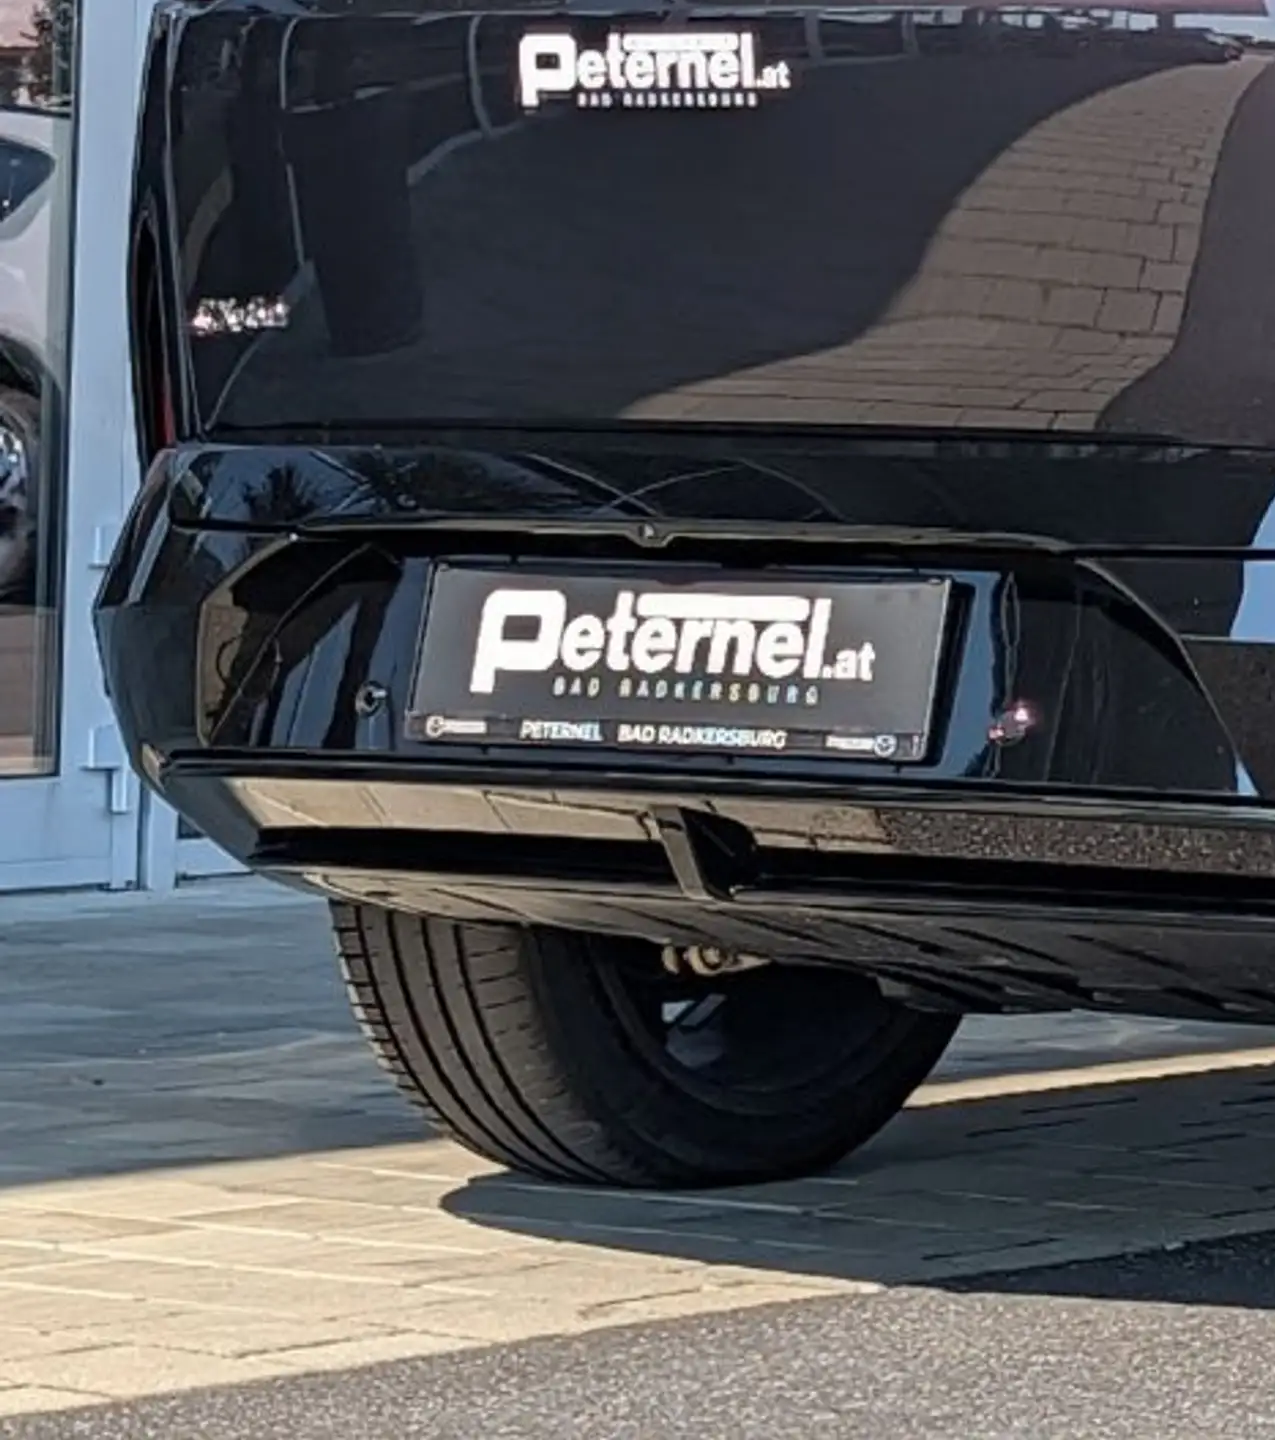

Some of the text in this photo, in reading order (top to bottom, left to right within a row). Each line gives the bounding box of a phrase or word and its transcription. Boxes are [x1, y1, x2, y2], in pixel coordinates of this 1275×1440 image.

[469, 588, 877, 694] Peternel.at
[552, 675, 600, 698] BAD
[617, 723, 655, 744] BAD
